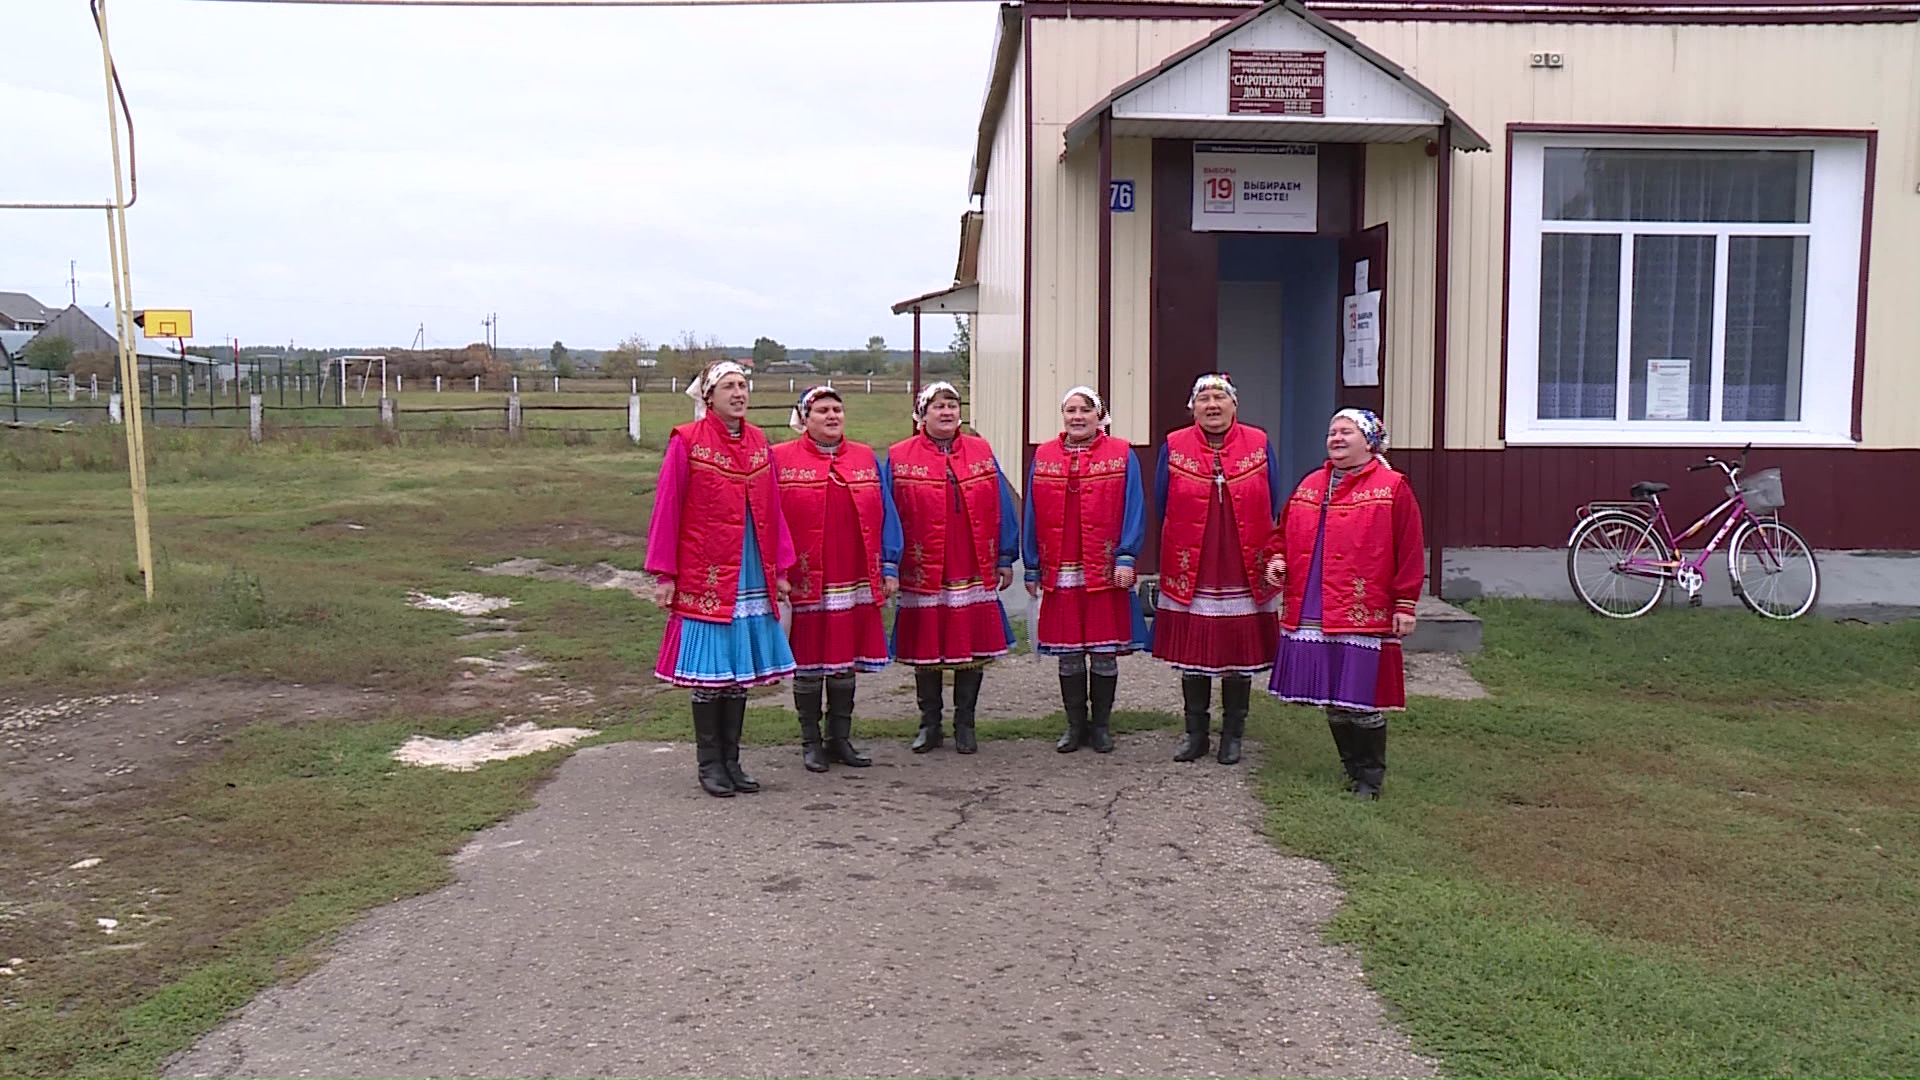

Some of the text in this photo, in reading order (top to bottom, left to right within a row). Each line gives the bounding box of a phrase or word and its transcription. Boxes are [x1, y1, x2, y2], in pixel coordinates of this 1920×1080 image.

[1243, 87, 1311, 99] ДОМ КУЛЬТУРЫ"
[1206, 177, 1233, 199] 19
[1243, 181, 1301, 191] ВЫБИРАЕМ
[1110, 183, 1131, 208] 76
[1243, 192, 1289, 201] ВМЕСТЕ!
